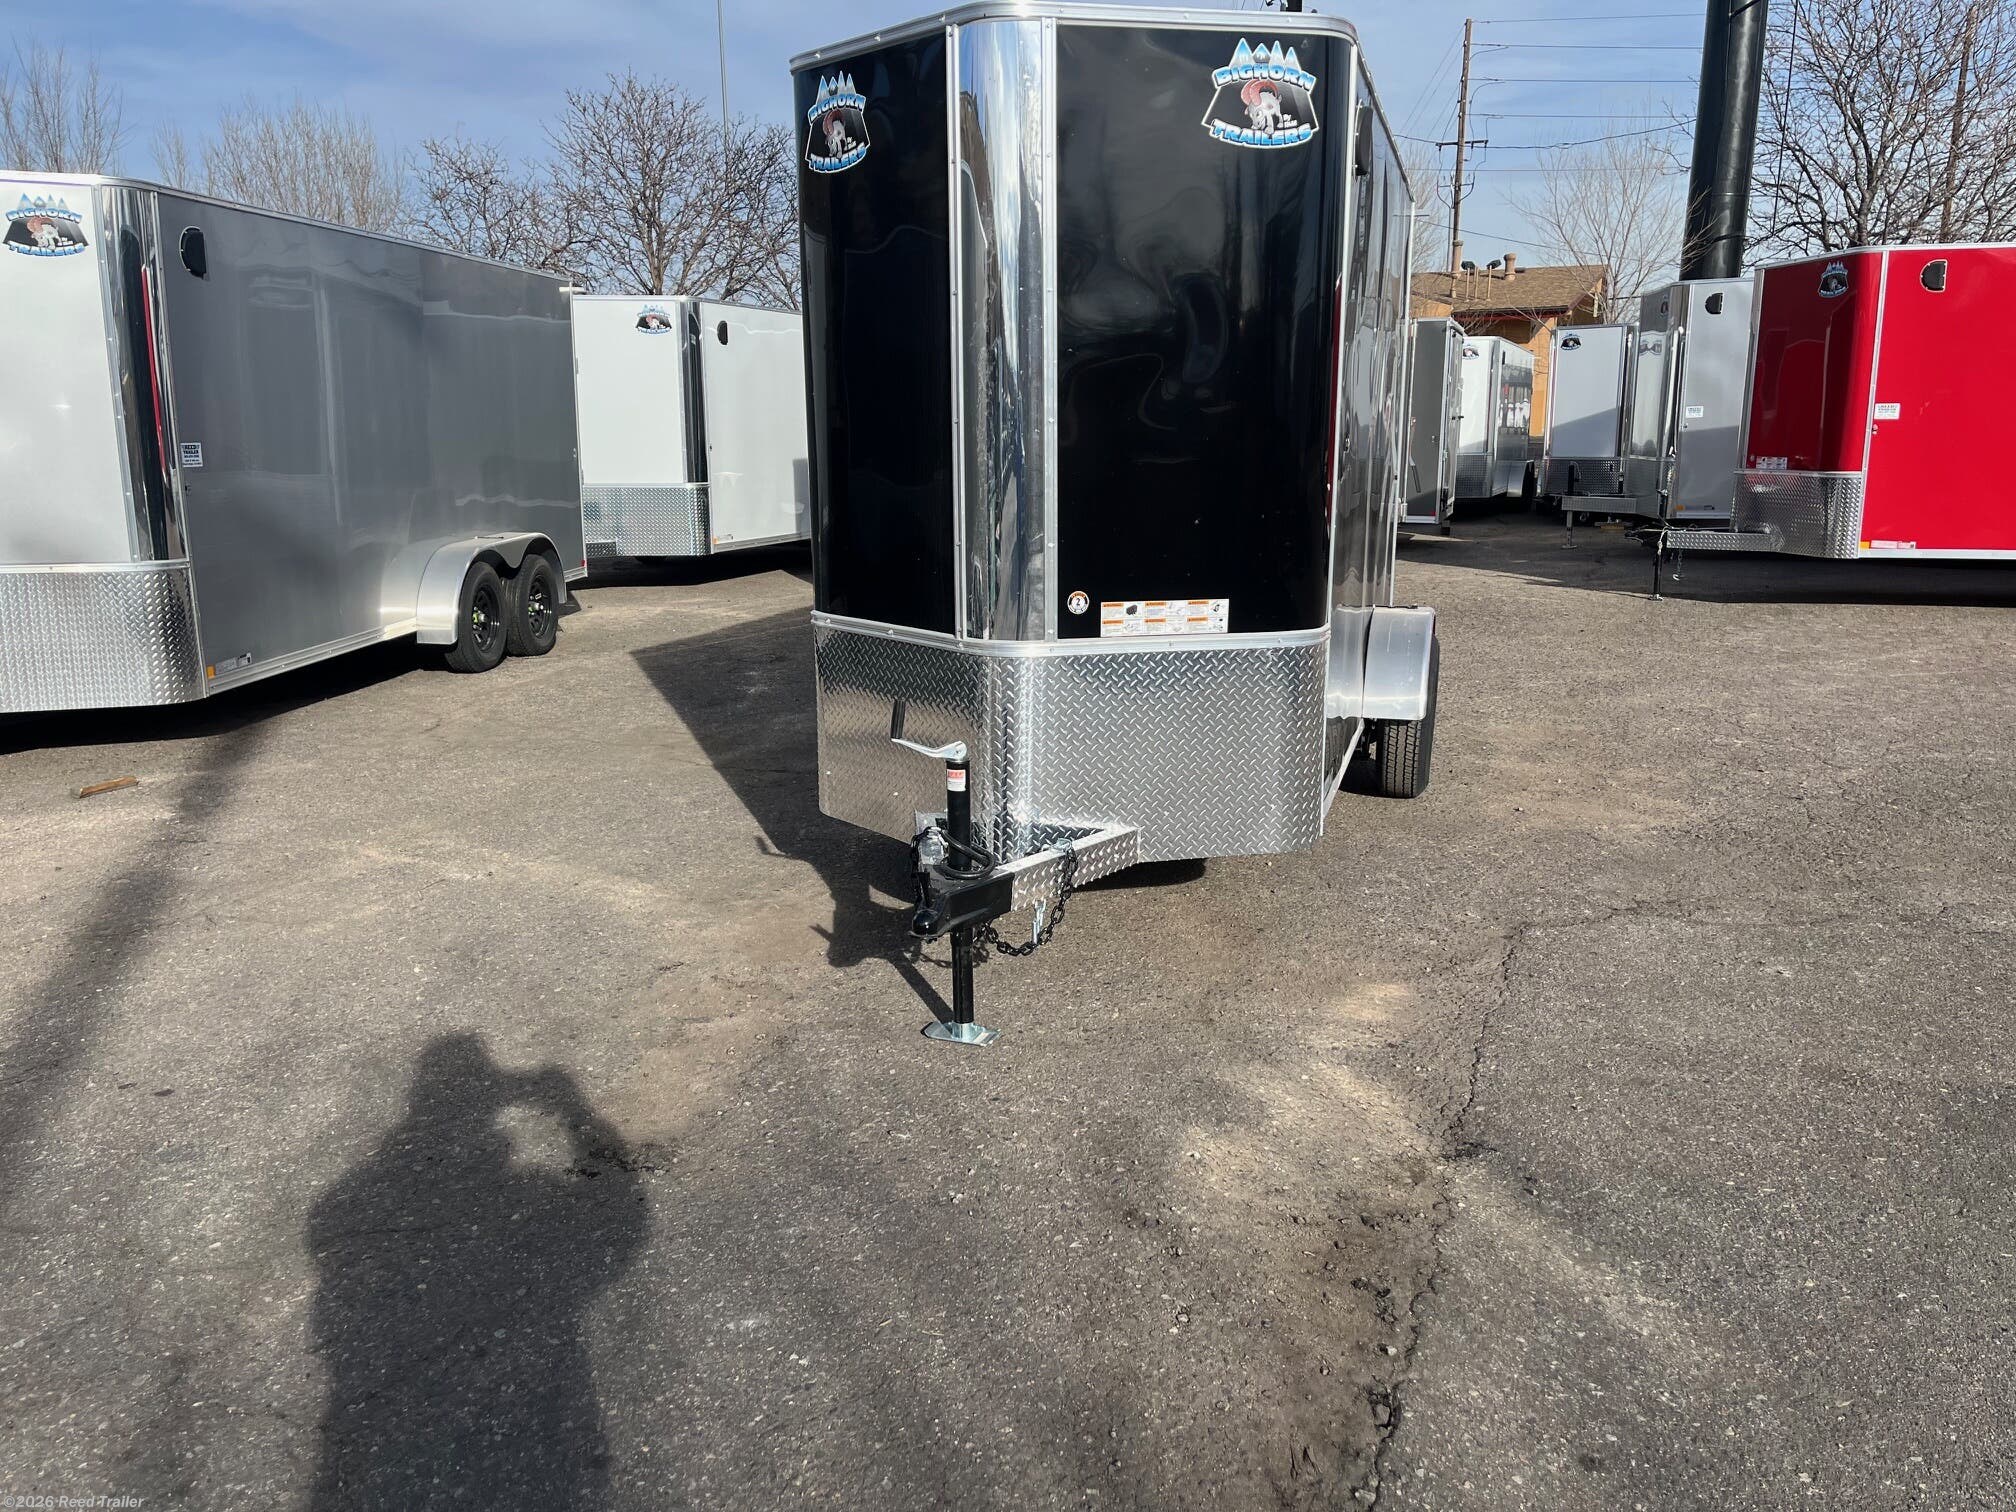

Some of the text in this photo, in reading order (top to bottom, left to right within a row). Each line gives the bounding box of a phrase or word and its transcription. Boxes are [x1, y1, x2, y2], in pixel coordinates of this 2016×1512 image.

[1214, 63, 1315, 91] BIGHORN
[808, 93, 866, 123] BIGHORN
[1210, 118, 1312, 146] TRAILERS
[809, 142, 867, 171] TRAILERS
[6, 207, 82, 224] BIGHORN
[7, 240, 86, 256] TRAILERS
